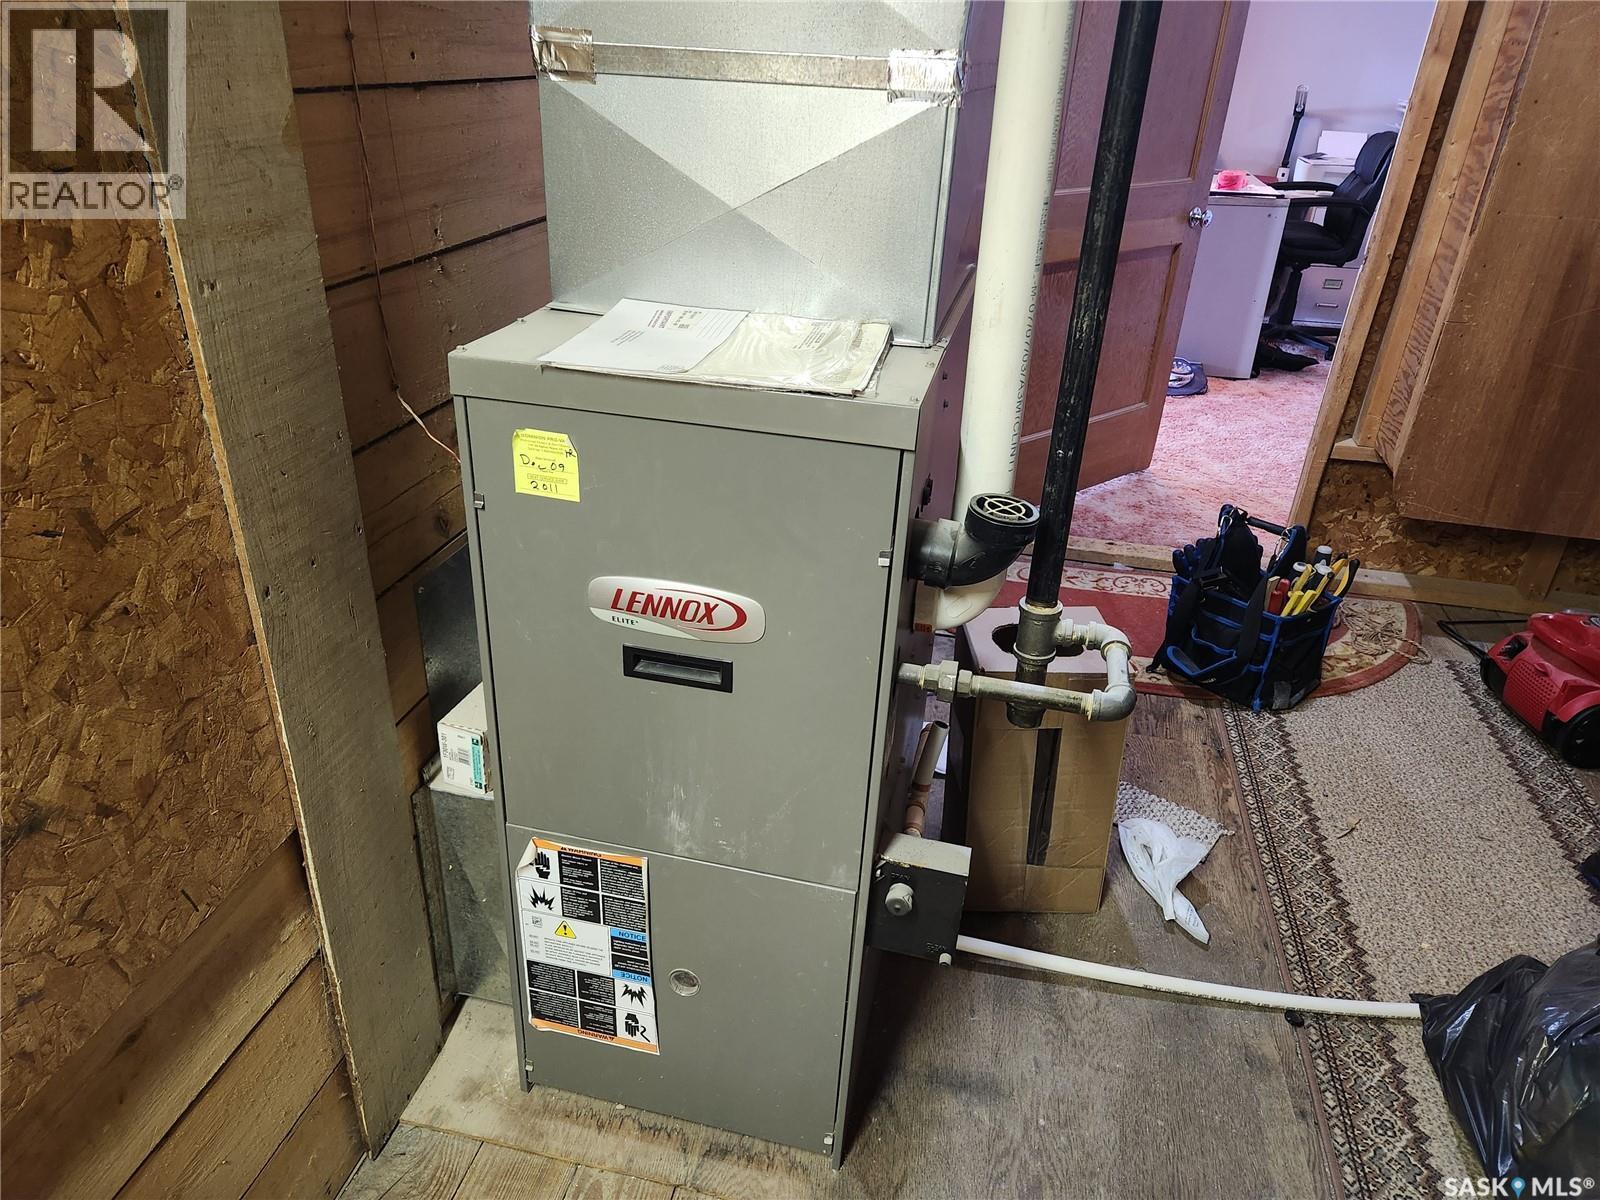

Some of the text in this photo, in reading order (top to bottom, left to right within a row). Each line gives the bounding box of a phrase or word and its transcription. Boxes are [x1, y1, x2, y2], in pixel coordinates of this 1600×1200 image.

[550, 462, 565, 472] 09
[530, 480, 558, 494] 2011
[610, 588, 719, 625] LENNOX
[618, 931, 646, 942] NOTICE
[620, 971, 649, 983] NOTICE
